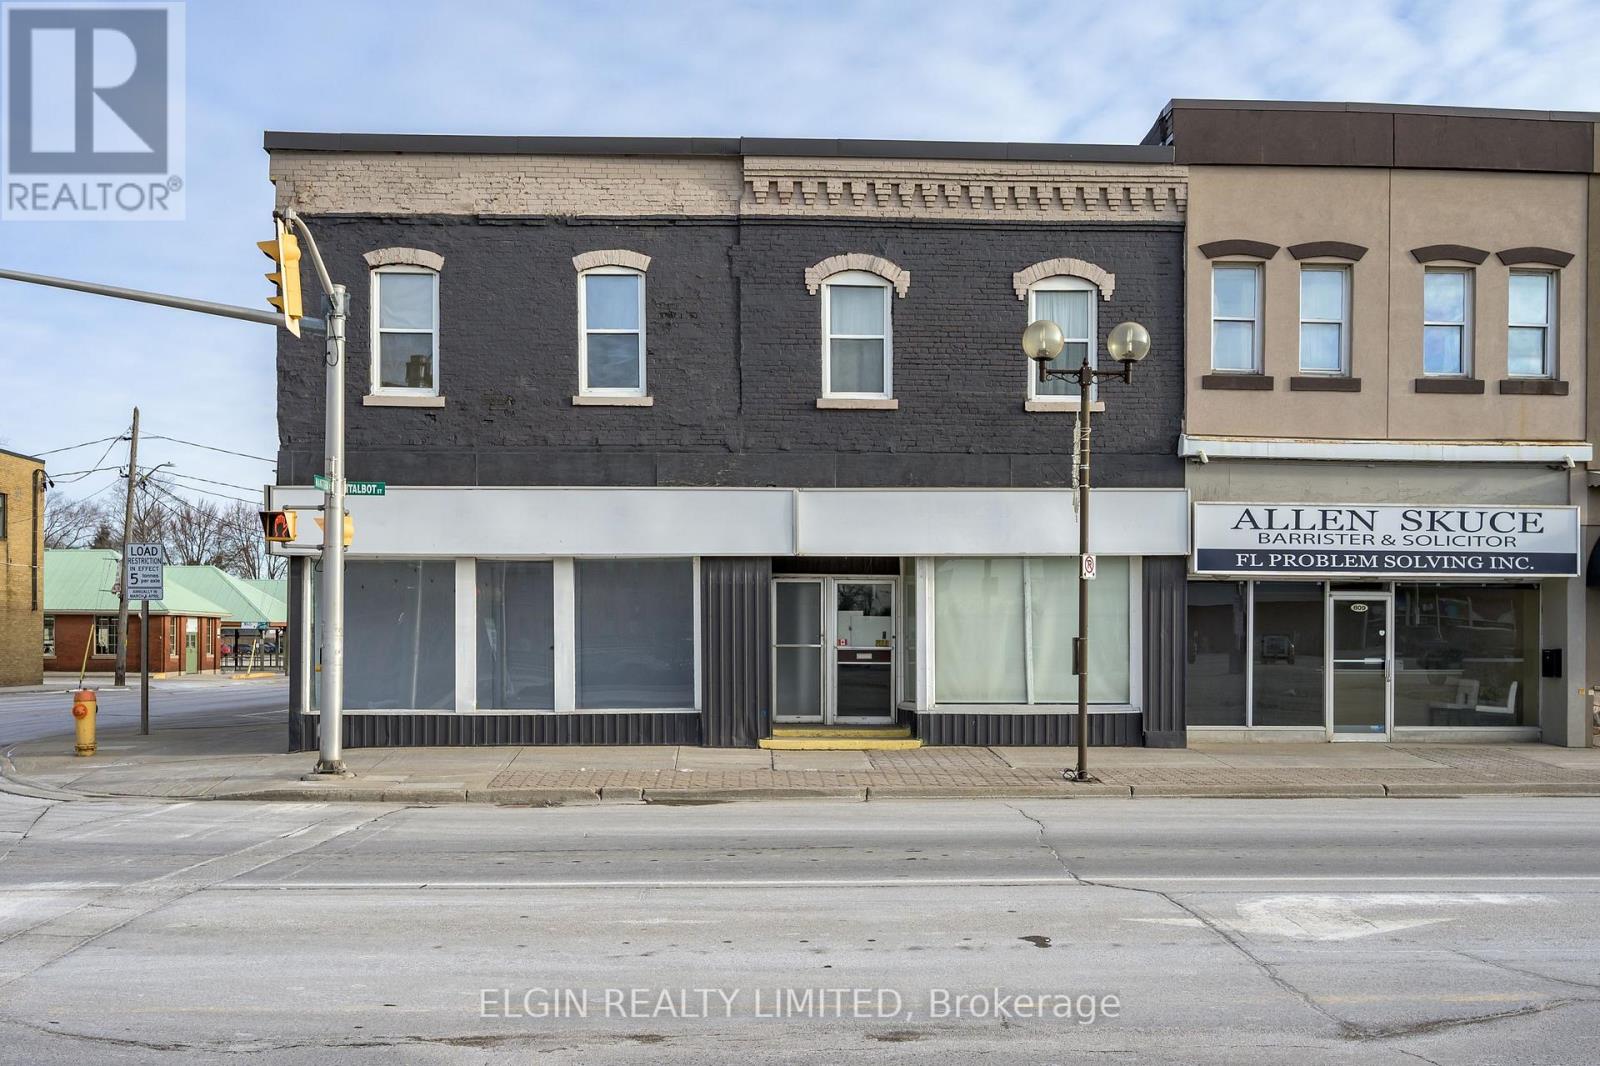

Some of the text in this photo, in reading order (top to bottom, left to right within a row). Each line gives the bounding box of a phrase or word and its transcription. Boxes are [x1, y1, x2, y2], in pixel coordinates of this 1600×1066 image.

[347, 484, 377, 494] TALBOT
[1230, 508, 1544, 534] ALLEN SKUCE
[1258, 532, 1517, 547] BARRISTER & SOLICITOR
[130, 546, 158, 556] LOAD
[128, 557, 162, 565] RESTRICTION
[1235, 553, 1534, 570] FL PROBLEM SOLVING INC.
[130, 573, 139, 585] 5
